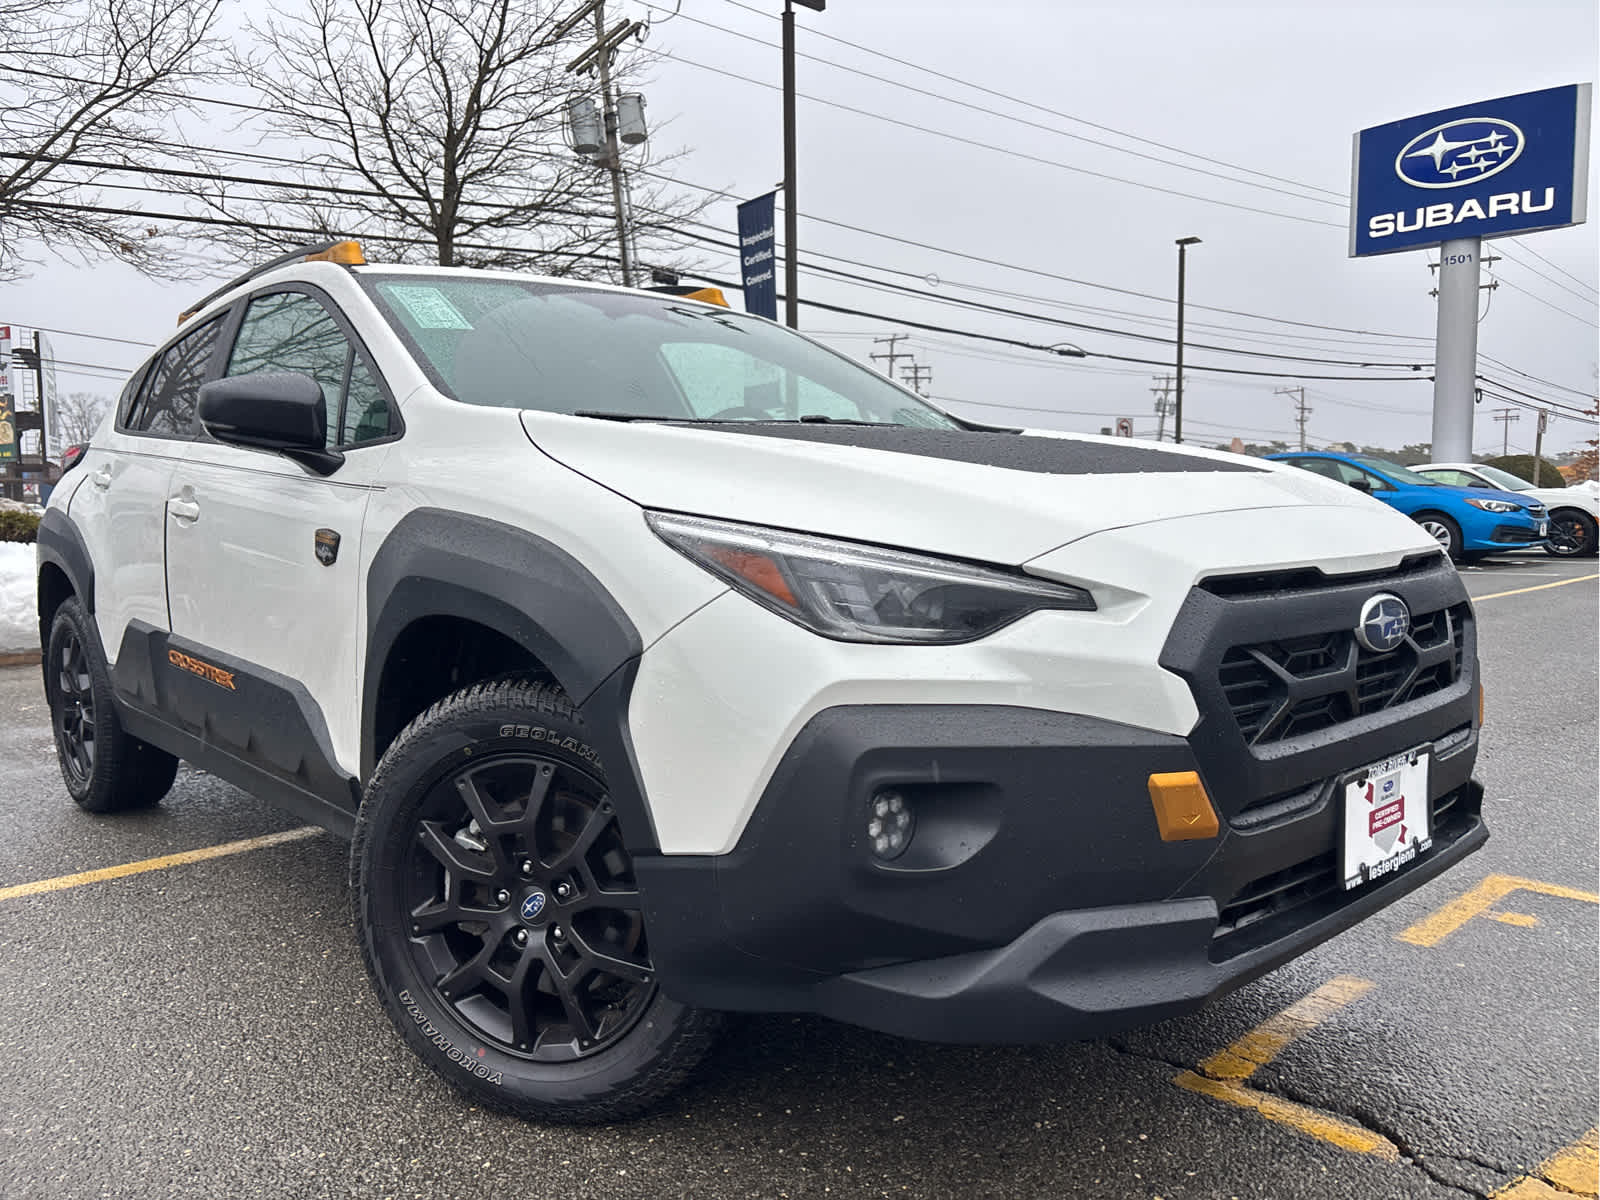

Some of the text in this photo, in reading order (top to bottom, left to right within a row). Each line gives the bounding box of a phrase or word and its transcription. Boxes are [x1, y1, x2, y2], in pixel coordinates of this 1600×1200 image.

[1369, 187, 1555, 238] SUBARU
[1444, 254, 1473, 265] 1501
[168, 649, 236, 690] CROSSTREK
[1369, 848, 1415, 880] lesterglenn
[399, 989, 503, 1086] YOKOHAMA
